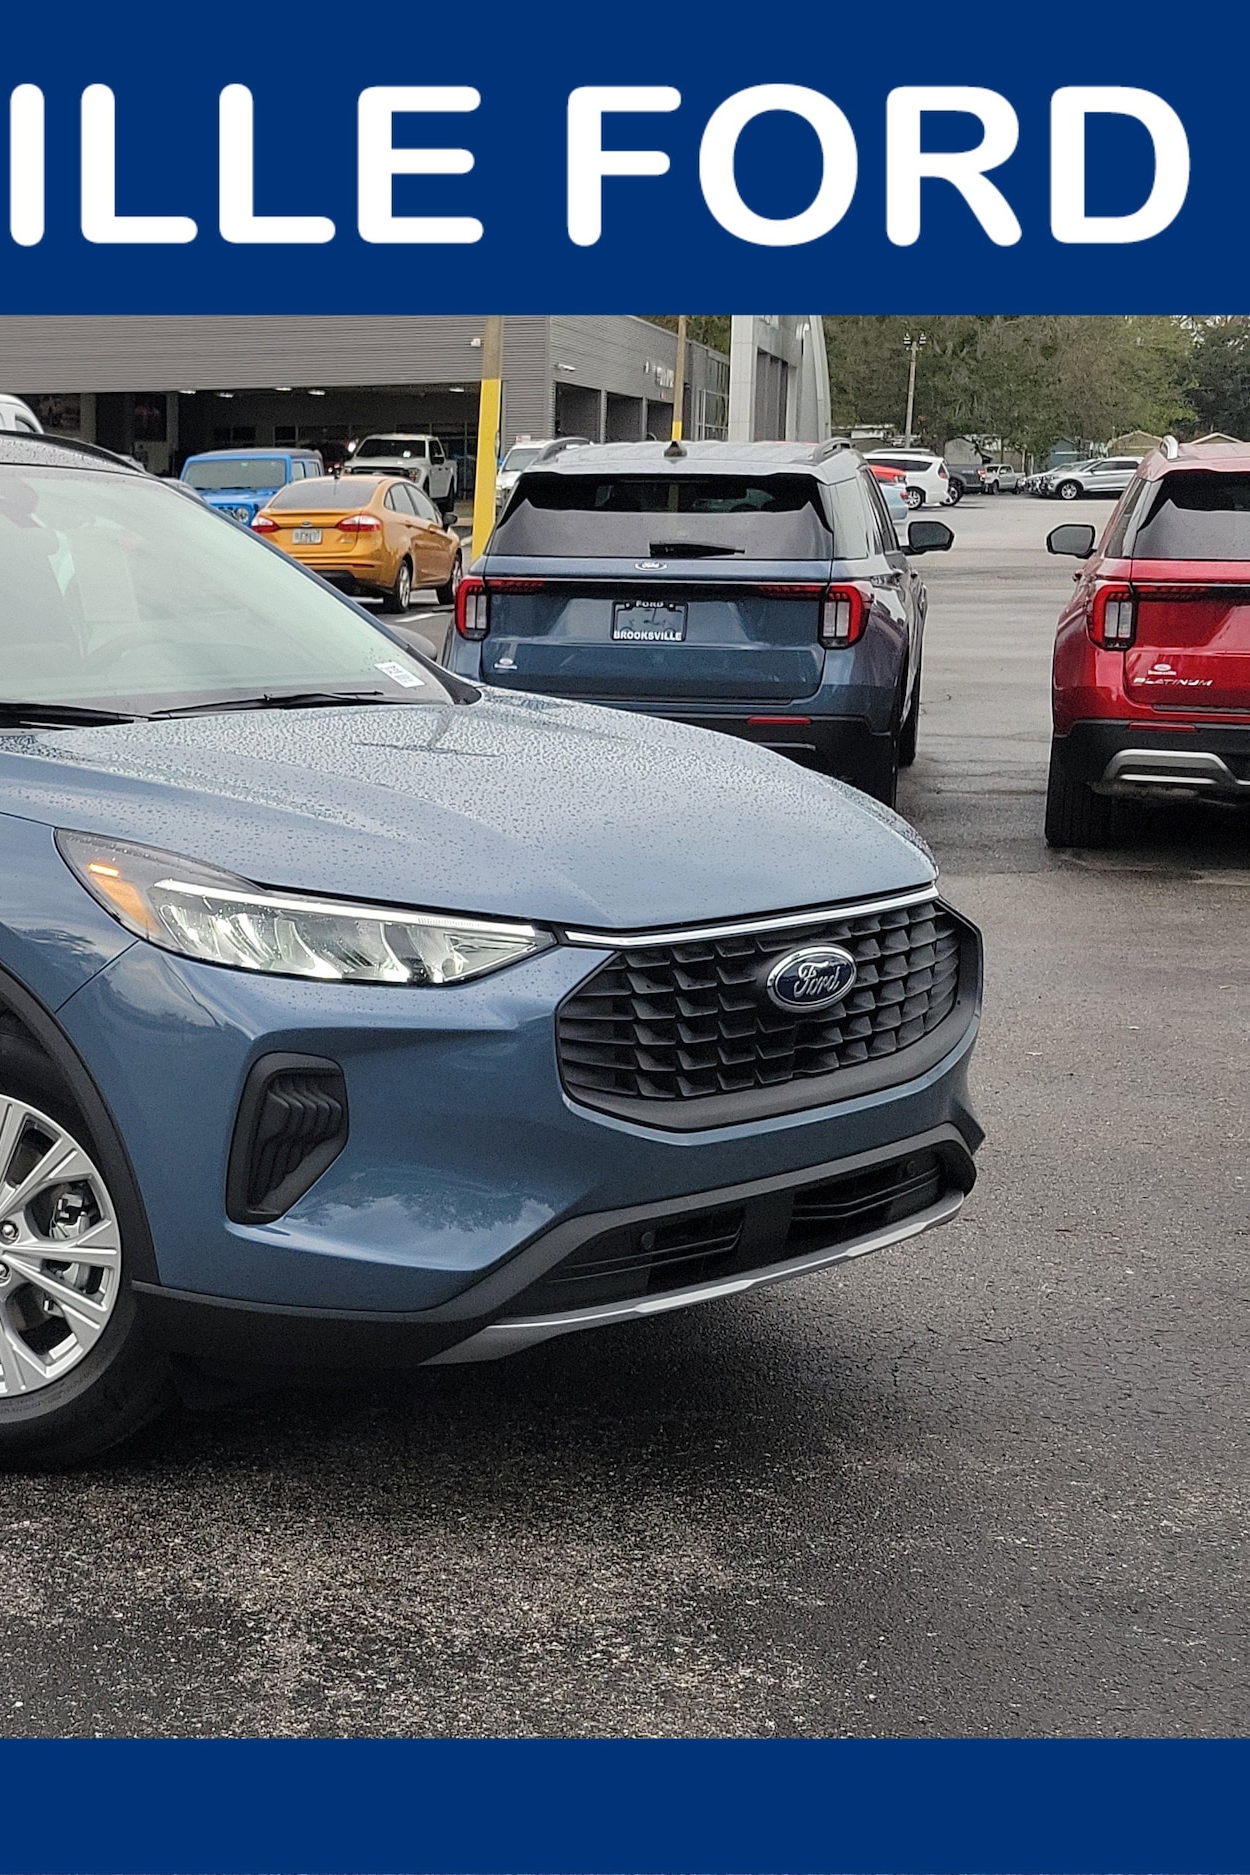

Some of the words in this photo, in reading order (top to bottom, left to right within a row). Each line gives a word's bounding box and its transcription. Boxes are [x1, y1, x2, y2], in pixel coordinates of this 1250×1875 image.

[613, 630, 683, 641] BROOKSVILLE
[1133, 677, 1213, 687] PLATINUM
[793, 961, 841, 999] Ford
